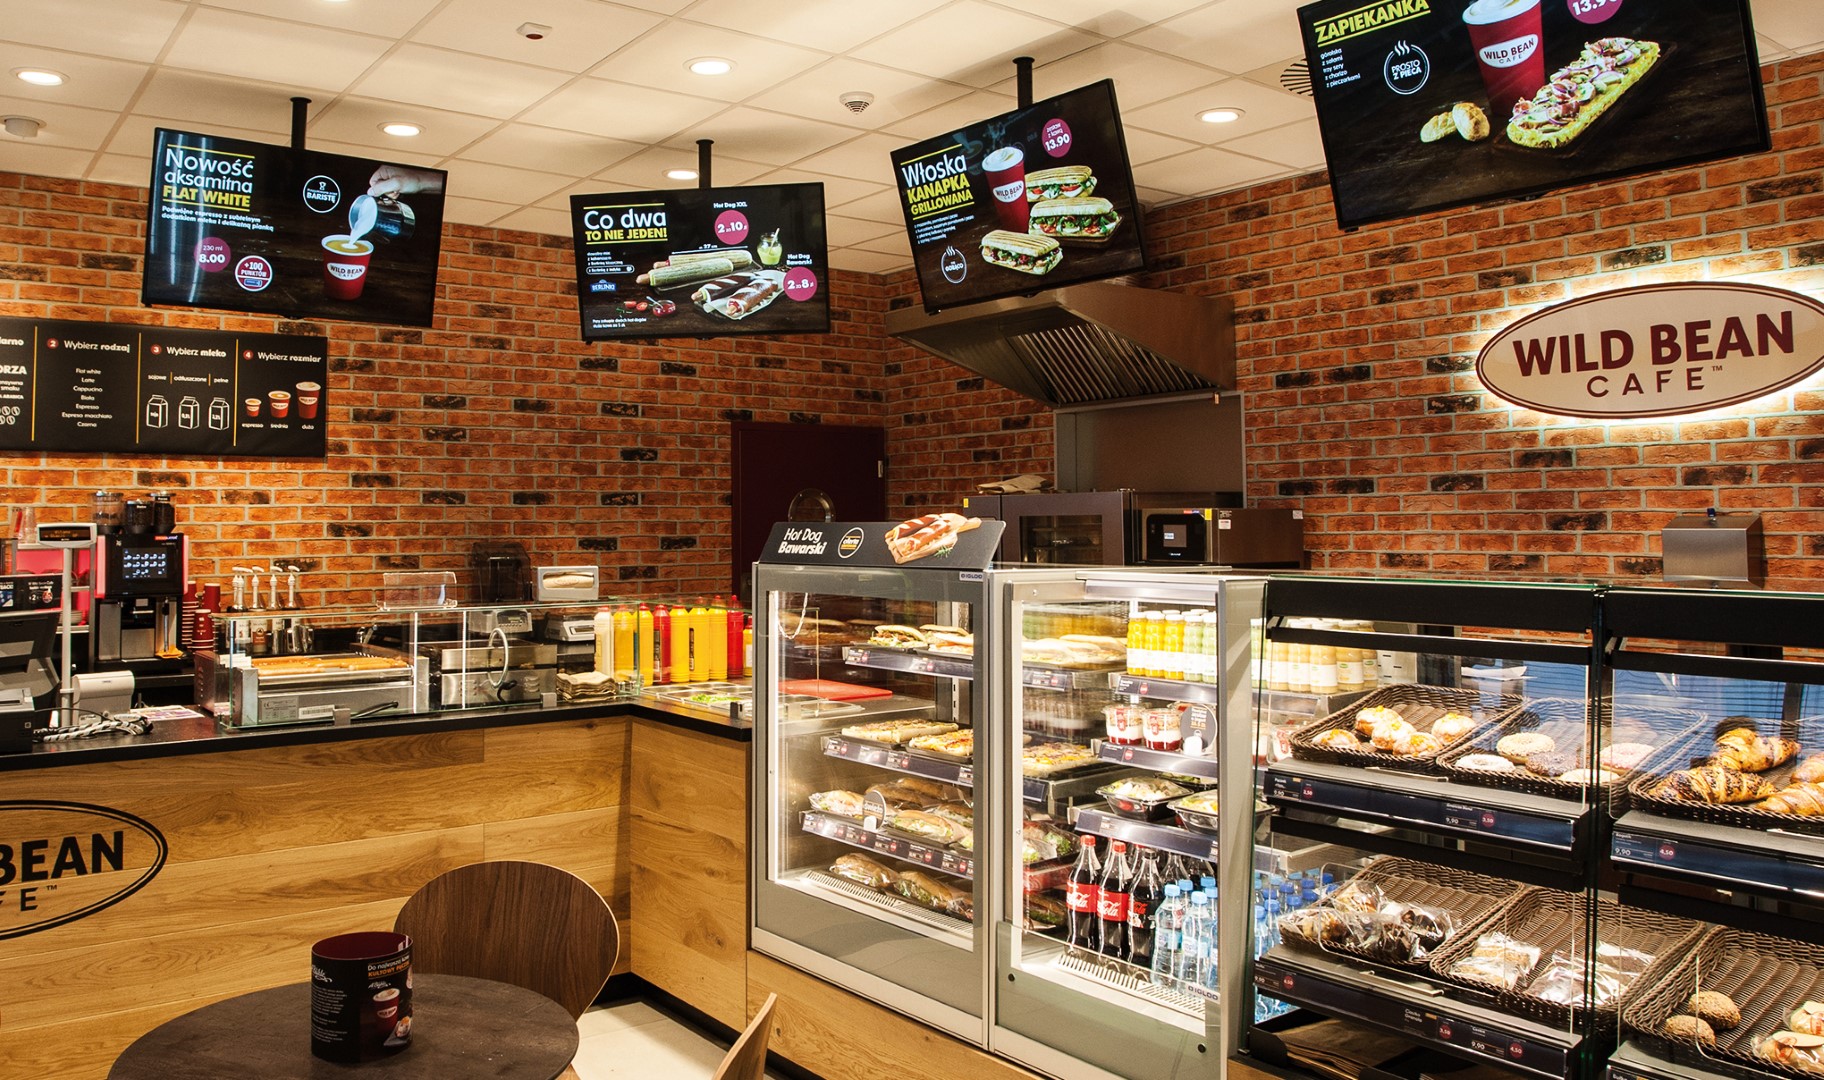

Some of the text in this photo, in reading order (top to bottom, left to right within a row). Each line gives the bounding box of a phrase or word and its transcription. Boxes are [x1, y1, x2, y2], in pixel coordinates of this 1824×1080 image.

[1572, 0, 1617, 16] 13.9
[1315, 0, 1430, 44] ZAPIEKANKA
[1484, 38, 1534, 60] WILD BEAN
[1391, 59, 1420, 74] PROSTO
[1498, 54, 1522, 64] CAFE
[1400, 66, 1422, 79] PIECA
[1045, 134, 1070, 151] 13.90
[165, 148, 254, 178] Nowość
[902, 154, 967, 188] Włoska
[164, 170, 253, 194] aksamitna
[907, 172, 970, 204] KANAPKA
[163, 185, 251, 207] FLAT WHITE
[911, 189, 974, 216] GRILLOWANA
[584, 208, 666, 230] Co dwa
[585, 228, 668, 241] TO NIE JEDEN!
[718, 224, 725, 233] 2
[730, 222, 744, 231] 10
[199, 254, 226, 264] 8.00
[244, 262, 264, 270] +100
[330, 265, 345, 274] WILD
[788, 280, 795, 290] 2
[801, 279, 810, 288] 8
[64, 340, 98, 350] Wybierz
[100, 344, 130, 353] rodzaj
[1512, 310, 1794, 377] WILD BEAN
[166, 346, 199, 356] Wybierz
[200, 349, 226, 358] mleko
[258, 352, 288, 362] Wybierz
[290, 355, 321, 363] rozmiar
[1586, 366, 1705, 398] CAFE
[784, 528, 823, 544] Hot Dog
[778, 541, 828, 554] Bawarski
[0, 831, 124, 886] BEAN
[1194, 988, 1218, 1000] IGLOO
